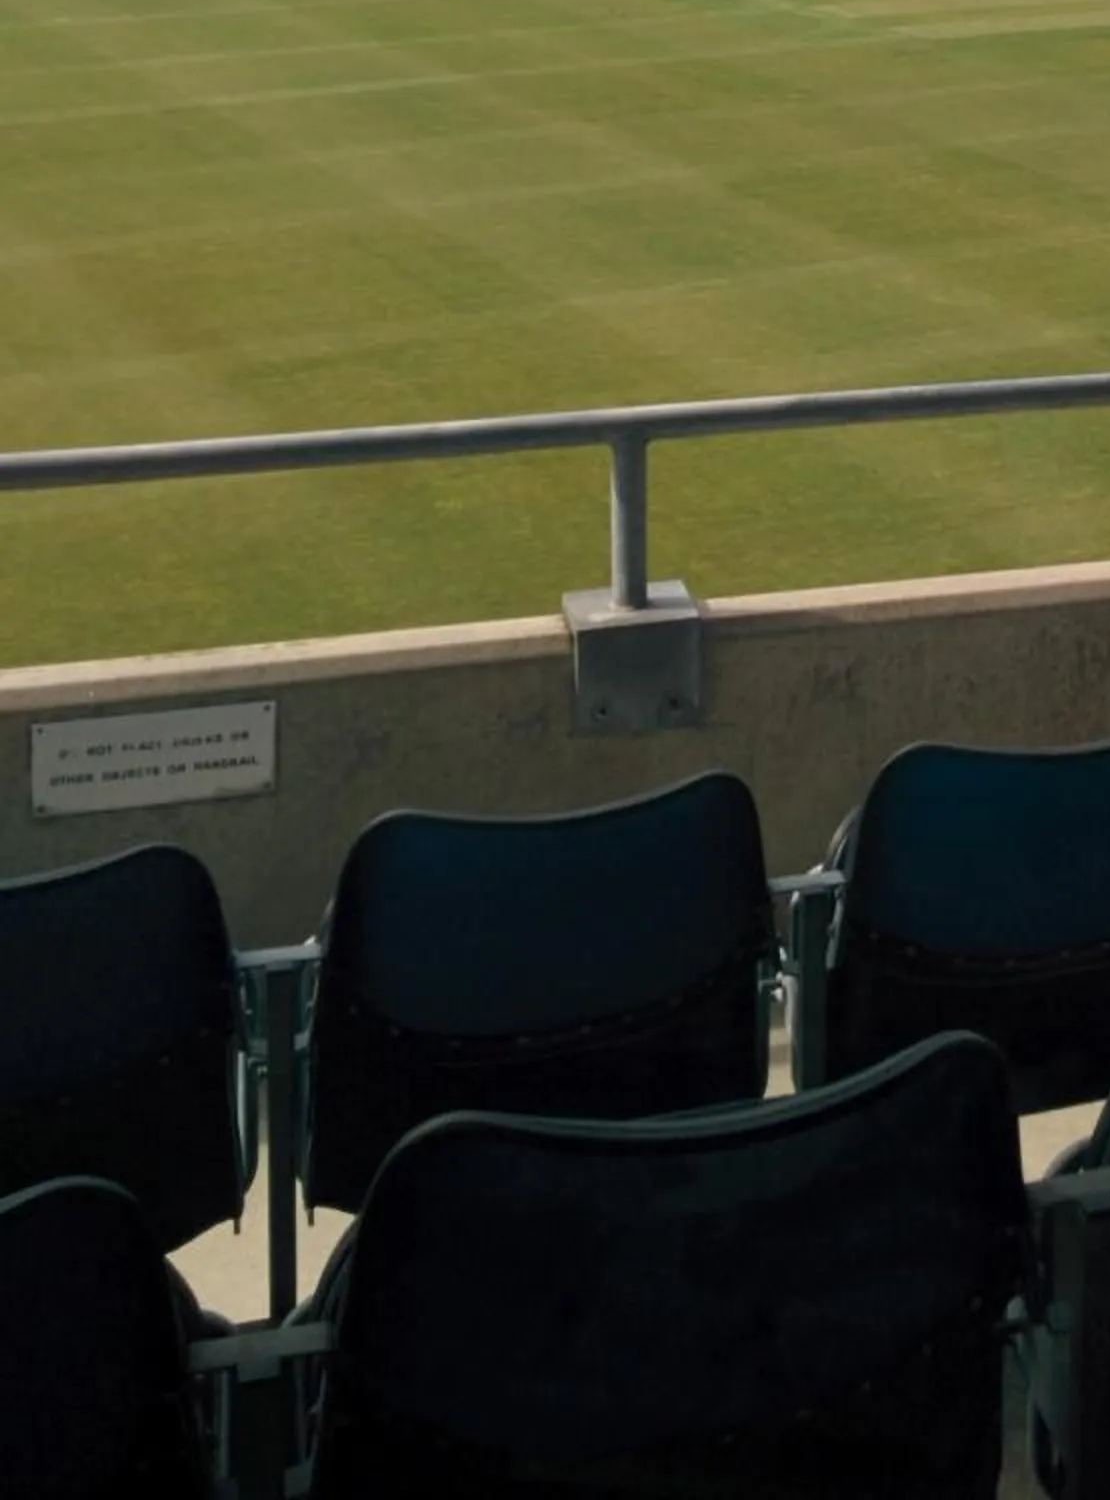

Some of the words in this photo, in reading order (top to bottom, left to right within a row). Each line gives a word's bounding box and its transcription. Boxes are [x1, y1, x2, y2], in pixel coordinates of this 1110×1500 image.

[86, 742, 112, 757] NOT
[49, 772, 94, 788] OTHER
[102, 765, 160, 781] OBJECTS
[194, 754, 260, 771] HANDRAIL
